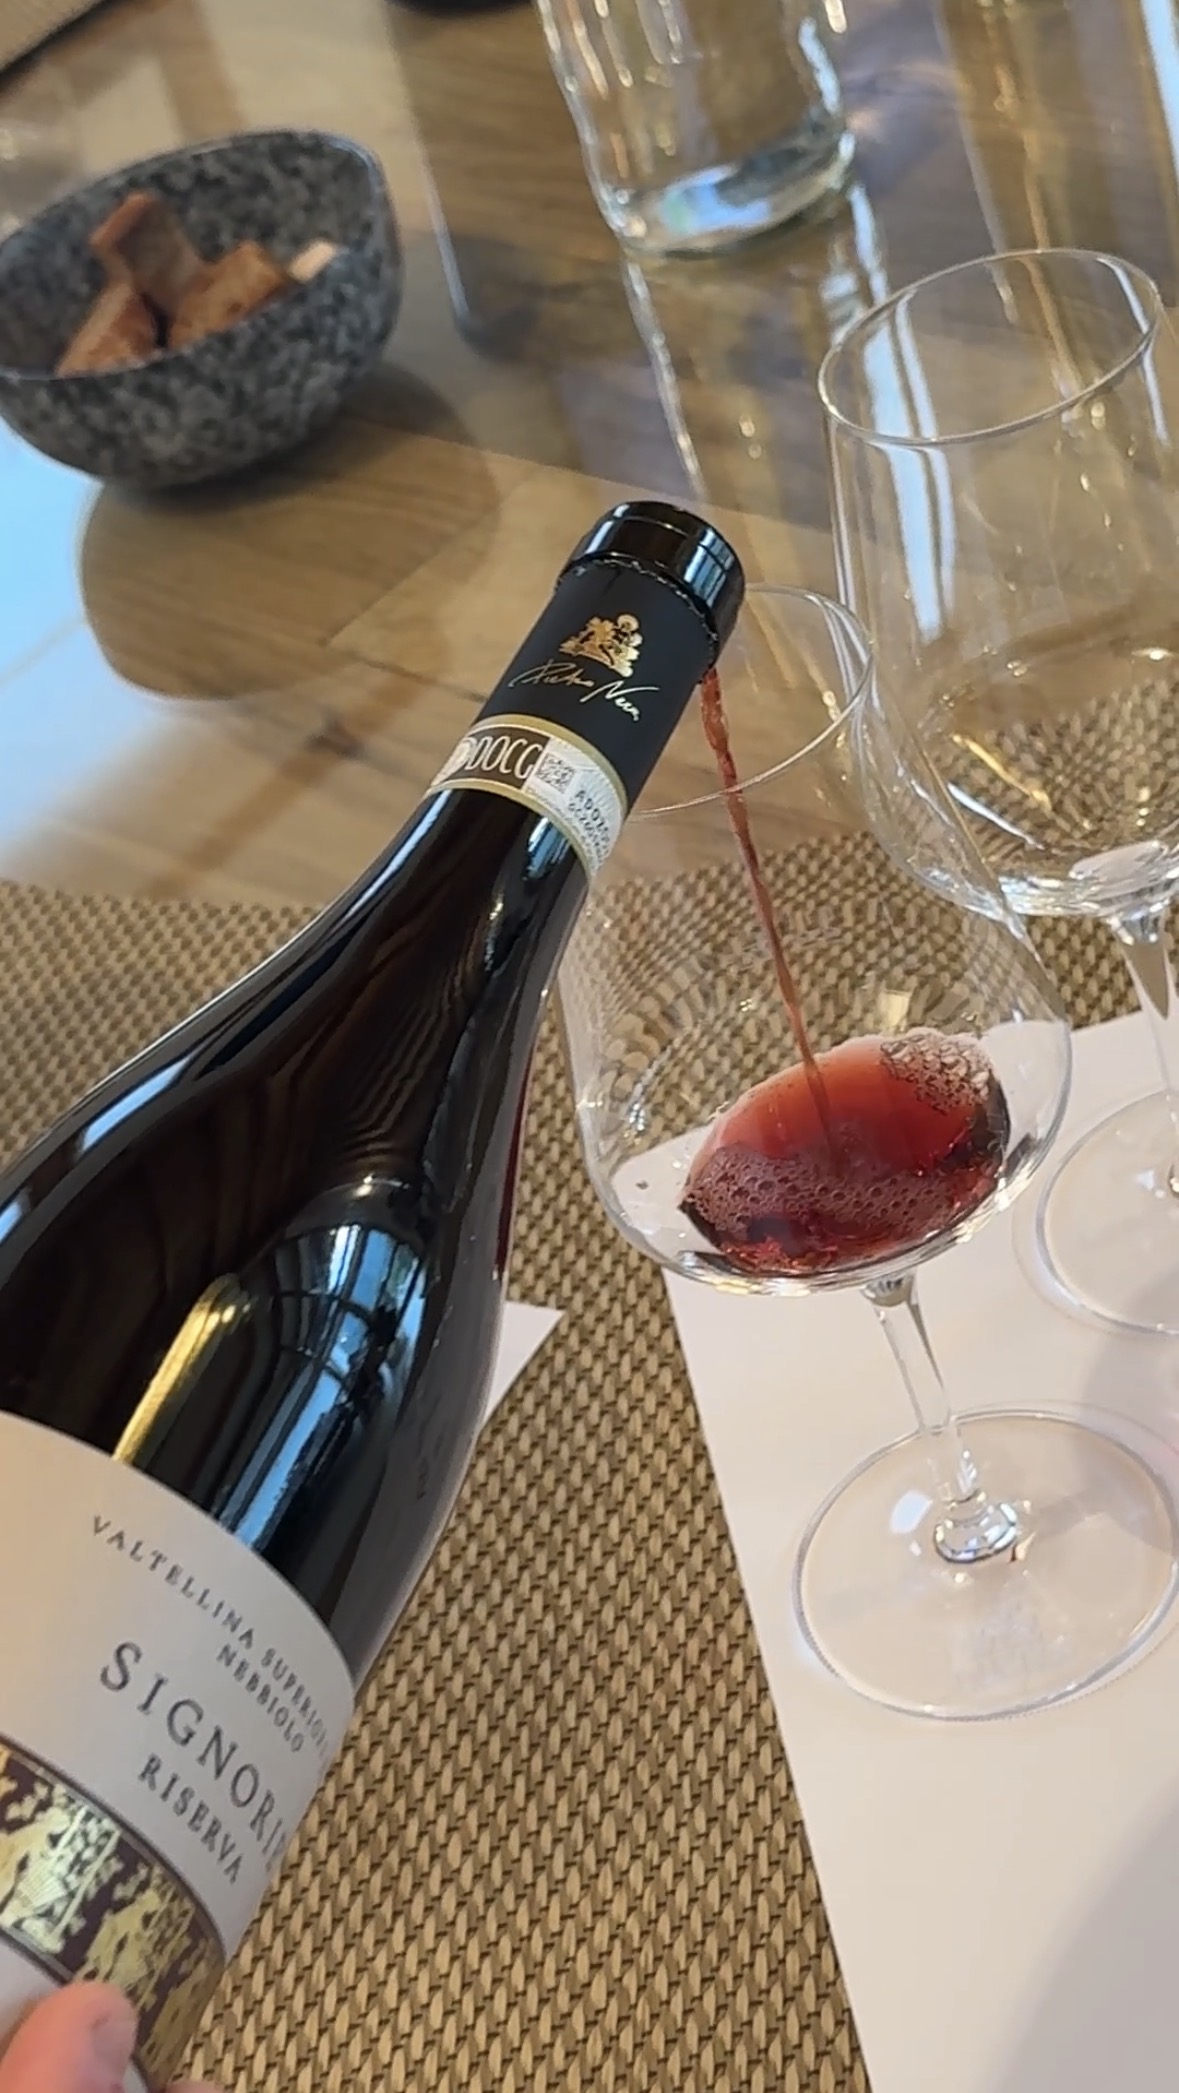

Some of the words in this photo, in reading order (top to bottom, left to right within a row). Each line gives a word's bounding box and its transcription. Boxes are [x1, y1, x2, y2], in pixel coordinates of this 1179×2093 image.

[464, 735, 543, 780] DOCG
[93, 1515, 254, 1650] VALTELLINA
[261, 1648, 329, 1756] SUPERIO
[216, 1643, 305, 1753] NEBBIOLO
[138, 1753, 243, 1885] RISERVA
